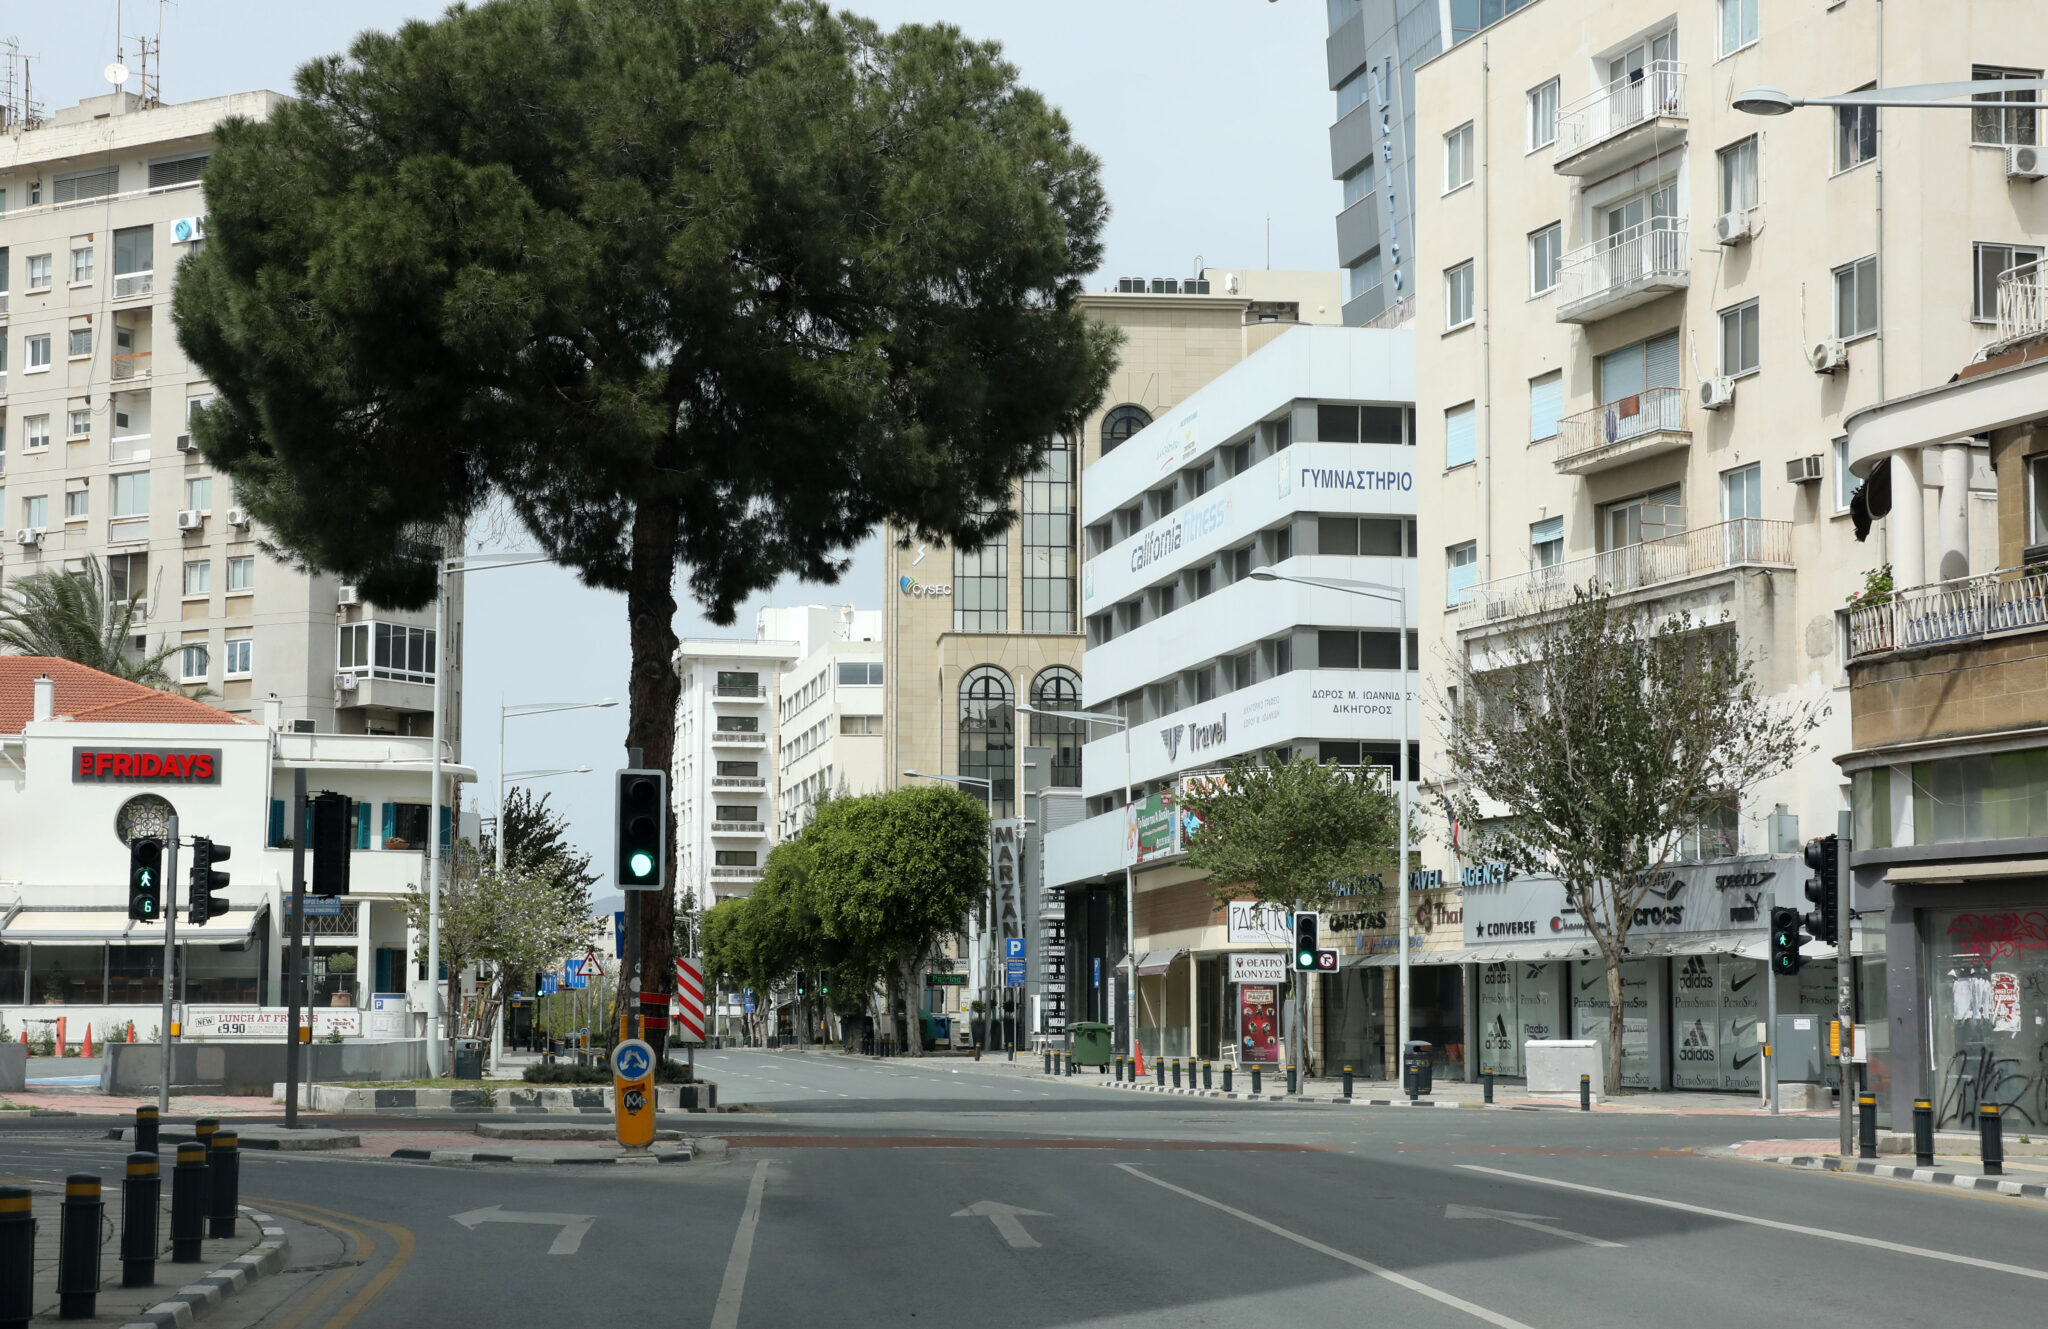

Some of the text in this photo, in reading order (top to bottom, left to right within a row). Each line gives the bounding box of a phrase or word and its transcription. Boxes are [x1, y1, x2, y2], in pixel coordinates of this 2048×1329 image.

[1302, 468, 1412, 492] ΓΥΜΝΑΣΤΗΡΙΟ
[1131, 498, 1224, 573] california fitness
[912, 584, 952, 595] CYSEC
[1312, 690, 1344, 699] ΔΩΡΟΣ
[1362, 690, 1412, 700] ΙΩΑΝΝΙΔΣ
[1333, 704, 1392, 715] ΔΙΚΗΓΟΡΟΣ
[1188, 712, 1226, 754] Travel
[80, 753, 213, 778] TGI FRIDAYS
[996, 827, 1018, 938] MARZAN
[1400, 870, 1442, 892] RAVEL
[1460, 864, 1508, 887] AGENCY
[144, 900, 152, 912] 6
[1633, 906, 1682, 926] crocs
[1487, 921, 1536, 936] CONVERSE
[1550, 916, 1607, 936] Champon
[1010, 941, 1021, 955] P
[1247, 959, 1282, 967] ΘΕΑΤΡΟ
[1782, 956, 1788, 966] 6
[1234, 970, 1282, 978] ΔΙΟΝΥΣΟΣ
[1485, 972, 1511, 984] adidas
[1680, 973, 1713, 989] adidas
[219, 1014, 254, 1023] LUNCH
[258, 1014, 272, 1023] AT
[1485, 1040, 1512, 1050] adidas
[1680, 1048, 1714, 1061] adidas
